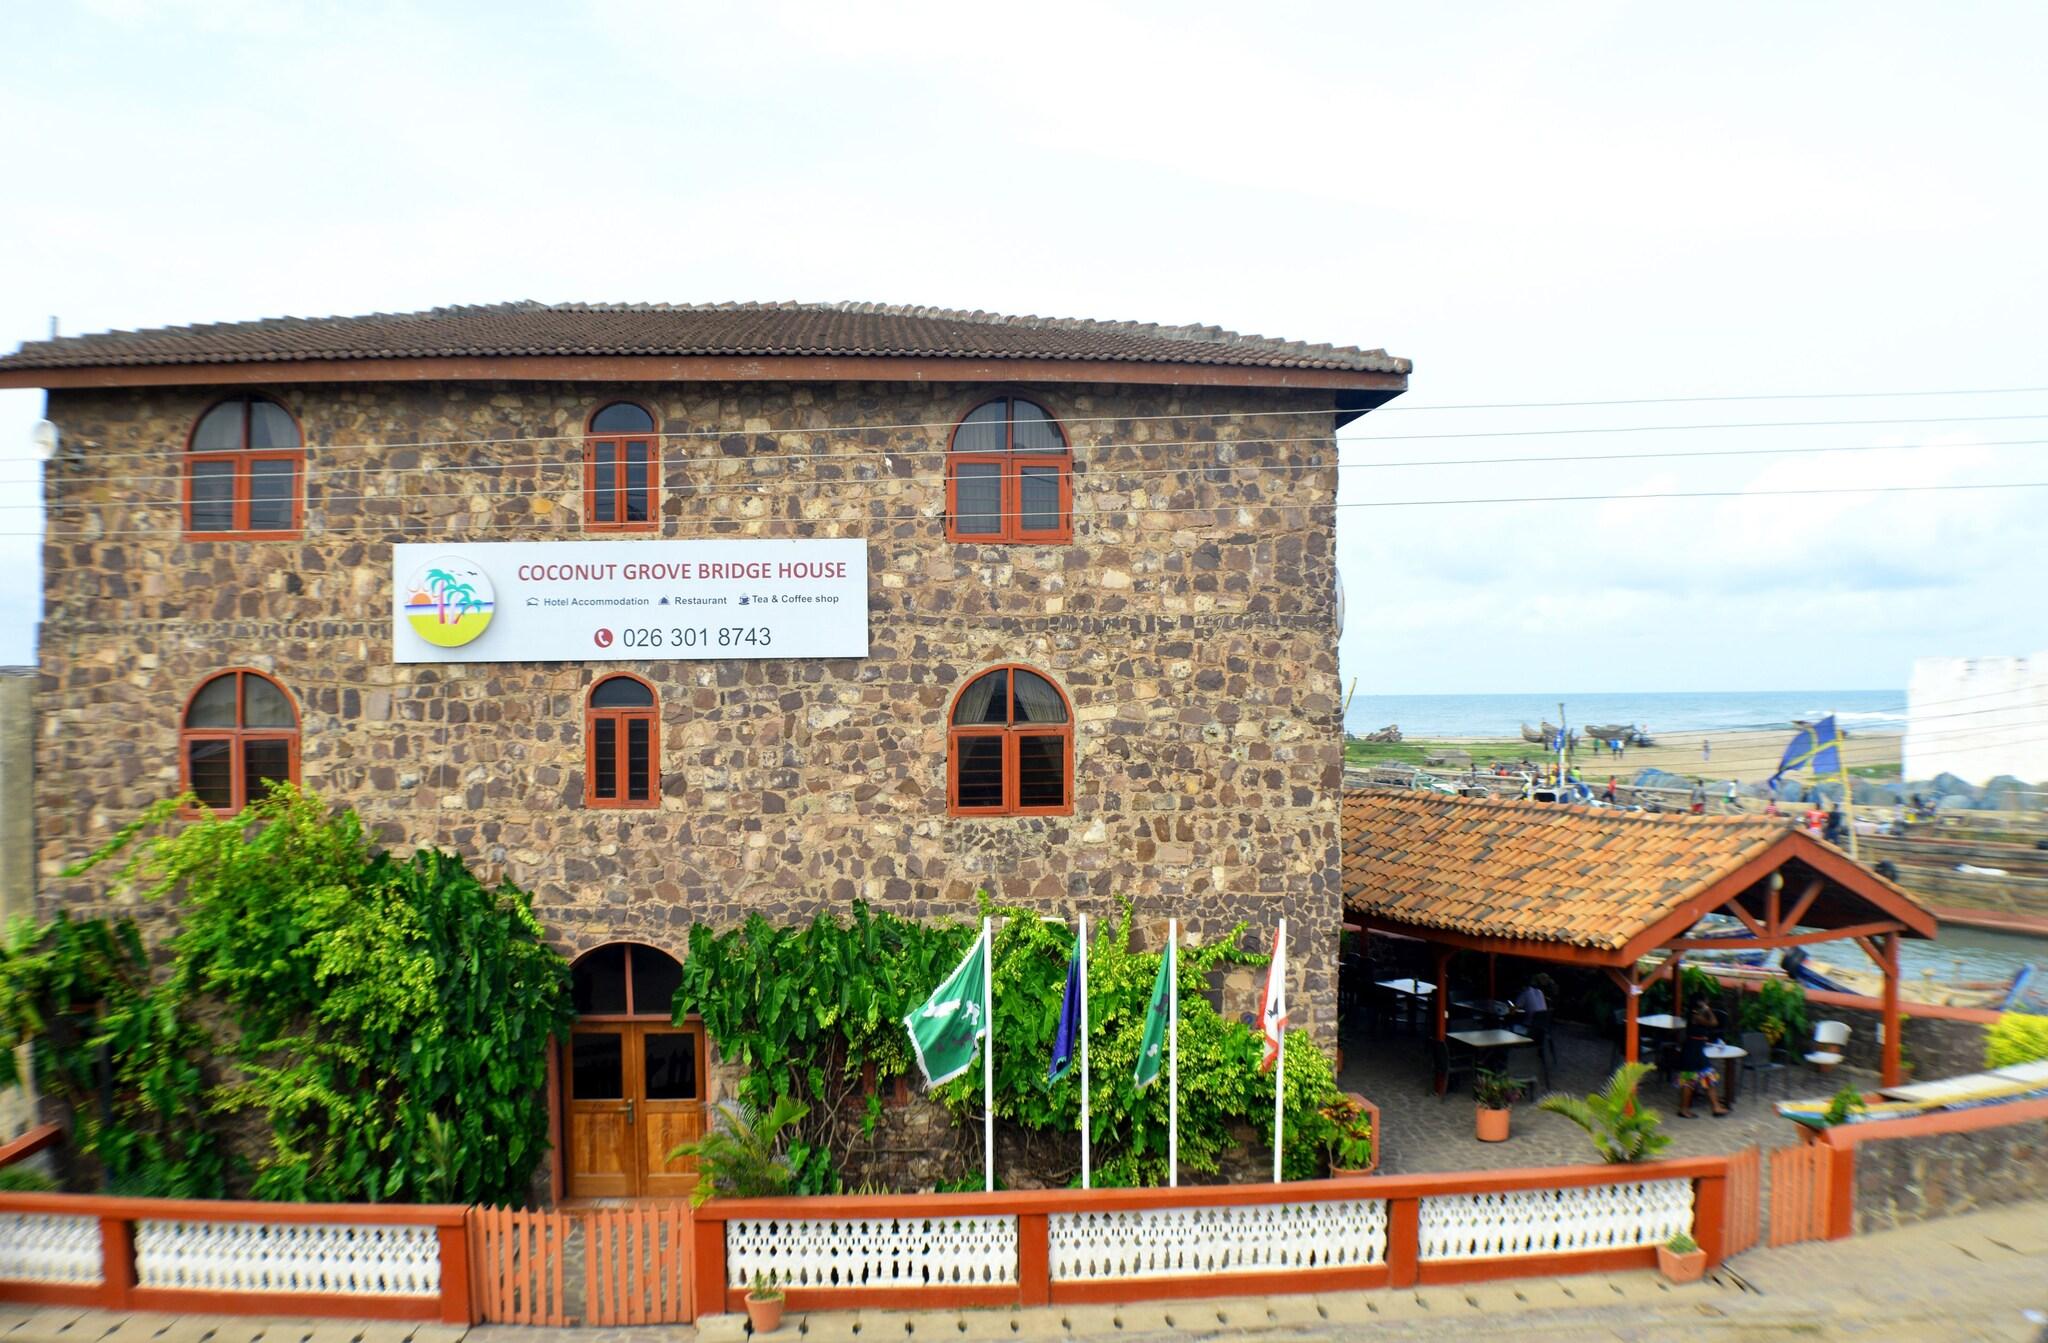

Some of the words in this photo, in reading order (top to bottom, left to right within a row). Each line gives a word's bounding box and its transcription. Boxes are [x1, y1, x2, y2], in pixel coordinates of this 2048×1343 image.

[518, 564, 617, 581] COCONUT
[623, 563, 691, 580] GROVE
[699, 562, 771, 579] BRIDGE
[779, 562, 846, 578] HOUSE
[544, 597, 568, 607] Hotel
[571, 597, 649, 606] Accommodation
[675, 596, 727, 605] Restaurant
[753, 595, 768, 603] Tea
[772, 595, 778, 603] &
[782, 594, 812, 603] Coffee
[815, 595, 839, 605] shop
[623, 628, 663, 648] 026
[671, 628, 707, 647] 301
[718, 627, 771, 647] 8743
